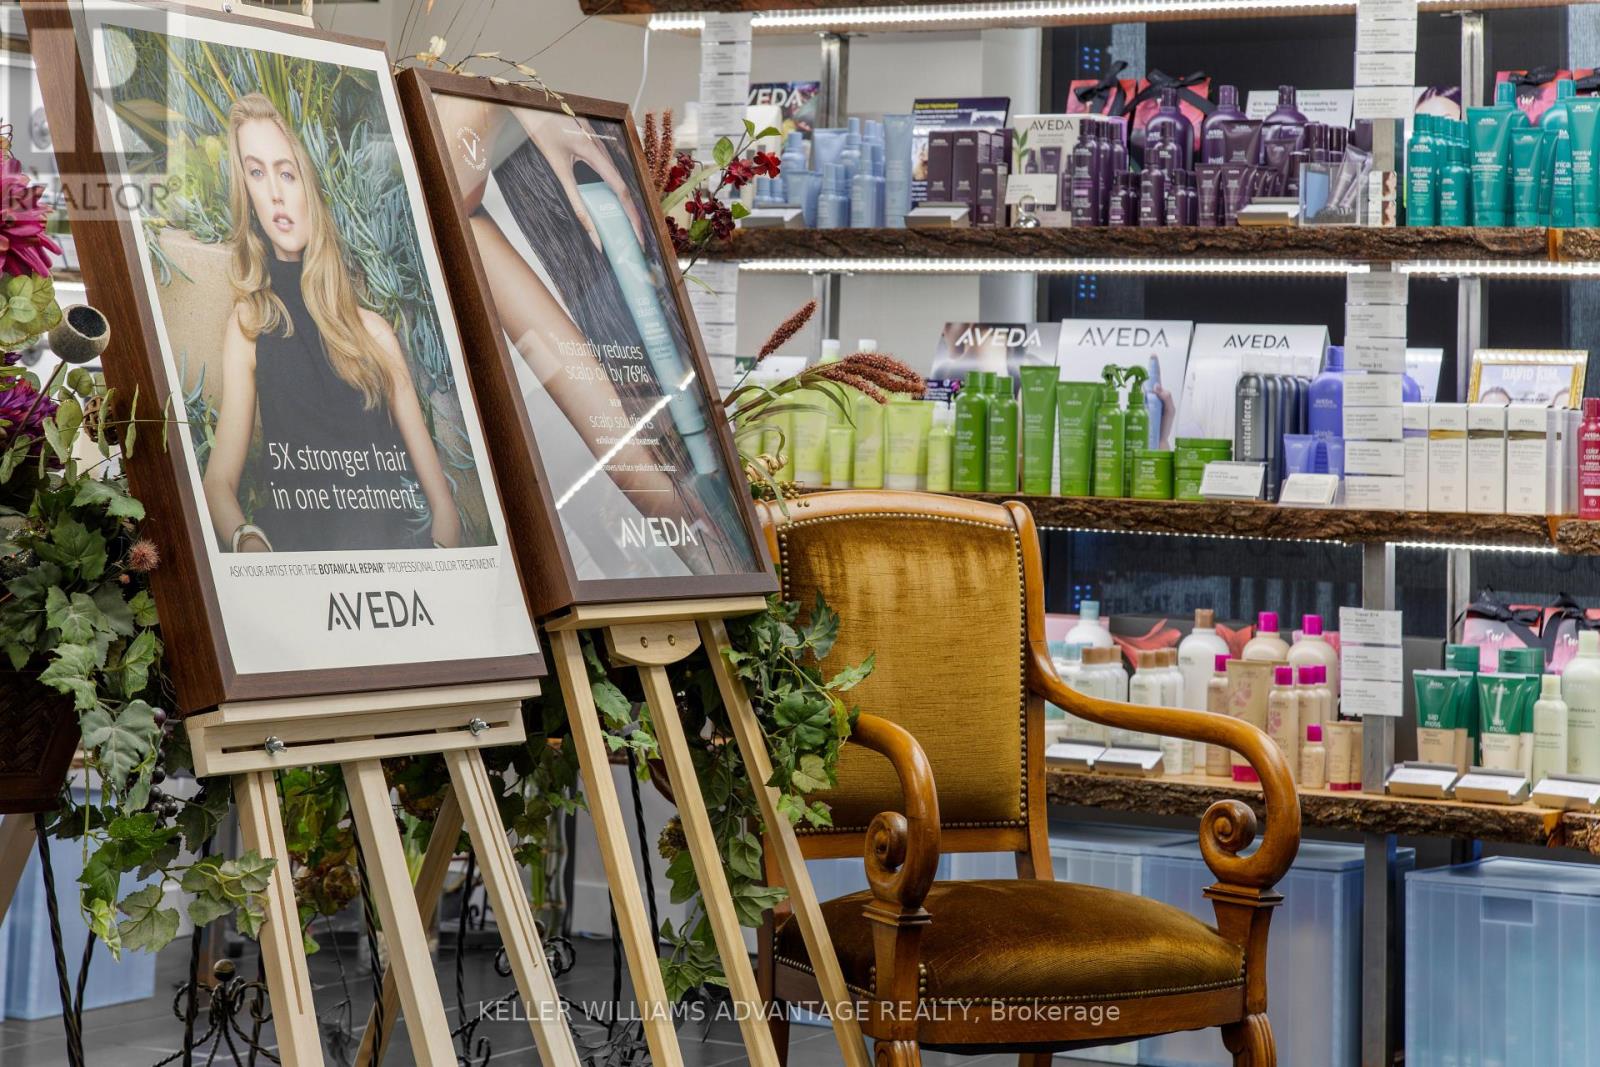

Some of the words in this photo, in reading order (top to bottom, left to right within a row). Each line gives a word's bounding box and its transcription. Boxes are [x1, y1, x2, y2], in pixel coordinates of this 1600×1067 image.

[1029, 119, 1074, 131] AVEDA
[955, 327, 1042, 347] AVEDA
[1078, 327, 1170, 347] AVEDA
[1223, 334, 1290, 349] AVEDA
[603, 340, 643, 360] reduces
[565, 361, 594, 385] scalp
[596, 363, 610, 381] oil
[608, 362, 623, 386] by
[589, 410, 613, 431] scalp
[269, 443, 295, 470] 5X
[297, 447, 370, 477] stronger
[372, 443, 407, 472] hair
[270, 481, 292, 509] in
[295, 488, 331, 510] one
[621, 517, 698, 548] AVEDA
[230, 565, 242, 577] ASK
[242, 565, 263, 577] YOUR
[265, 564, 288, 577] ARTIST
[289, 564, 303, 576] FOR
[304, 563, 319, 576] THE
[319, 562, 359, 575] BOTANICAL
[388, 560, 436, 573] PROFESSIONAL
[436, 559, 458, 572] COLOR
[328, 588, 435, 631] AVEDA
